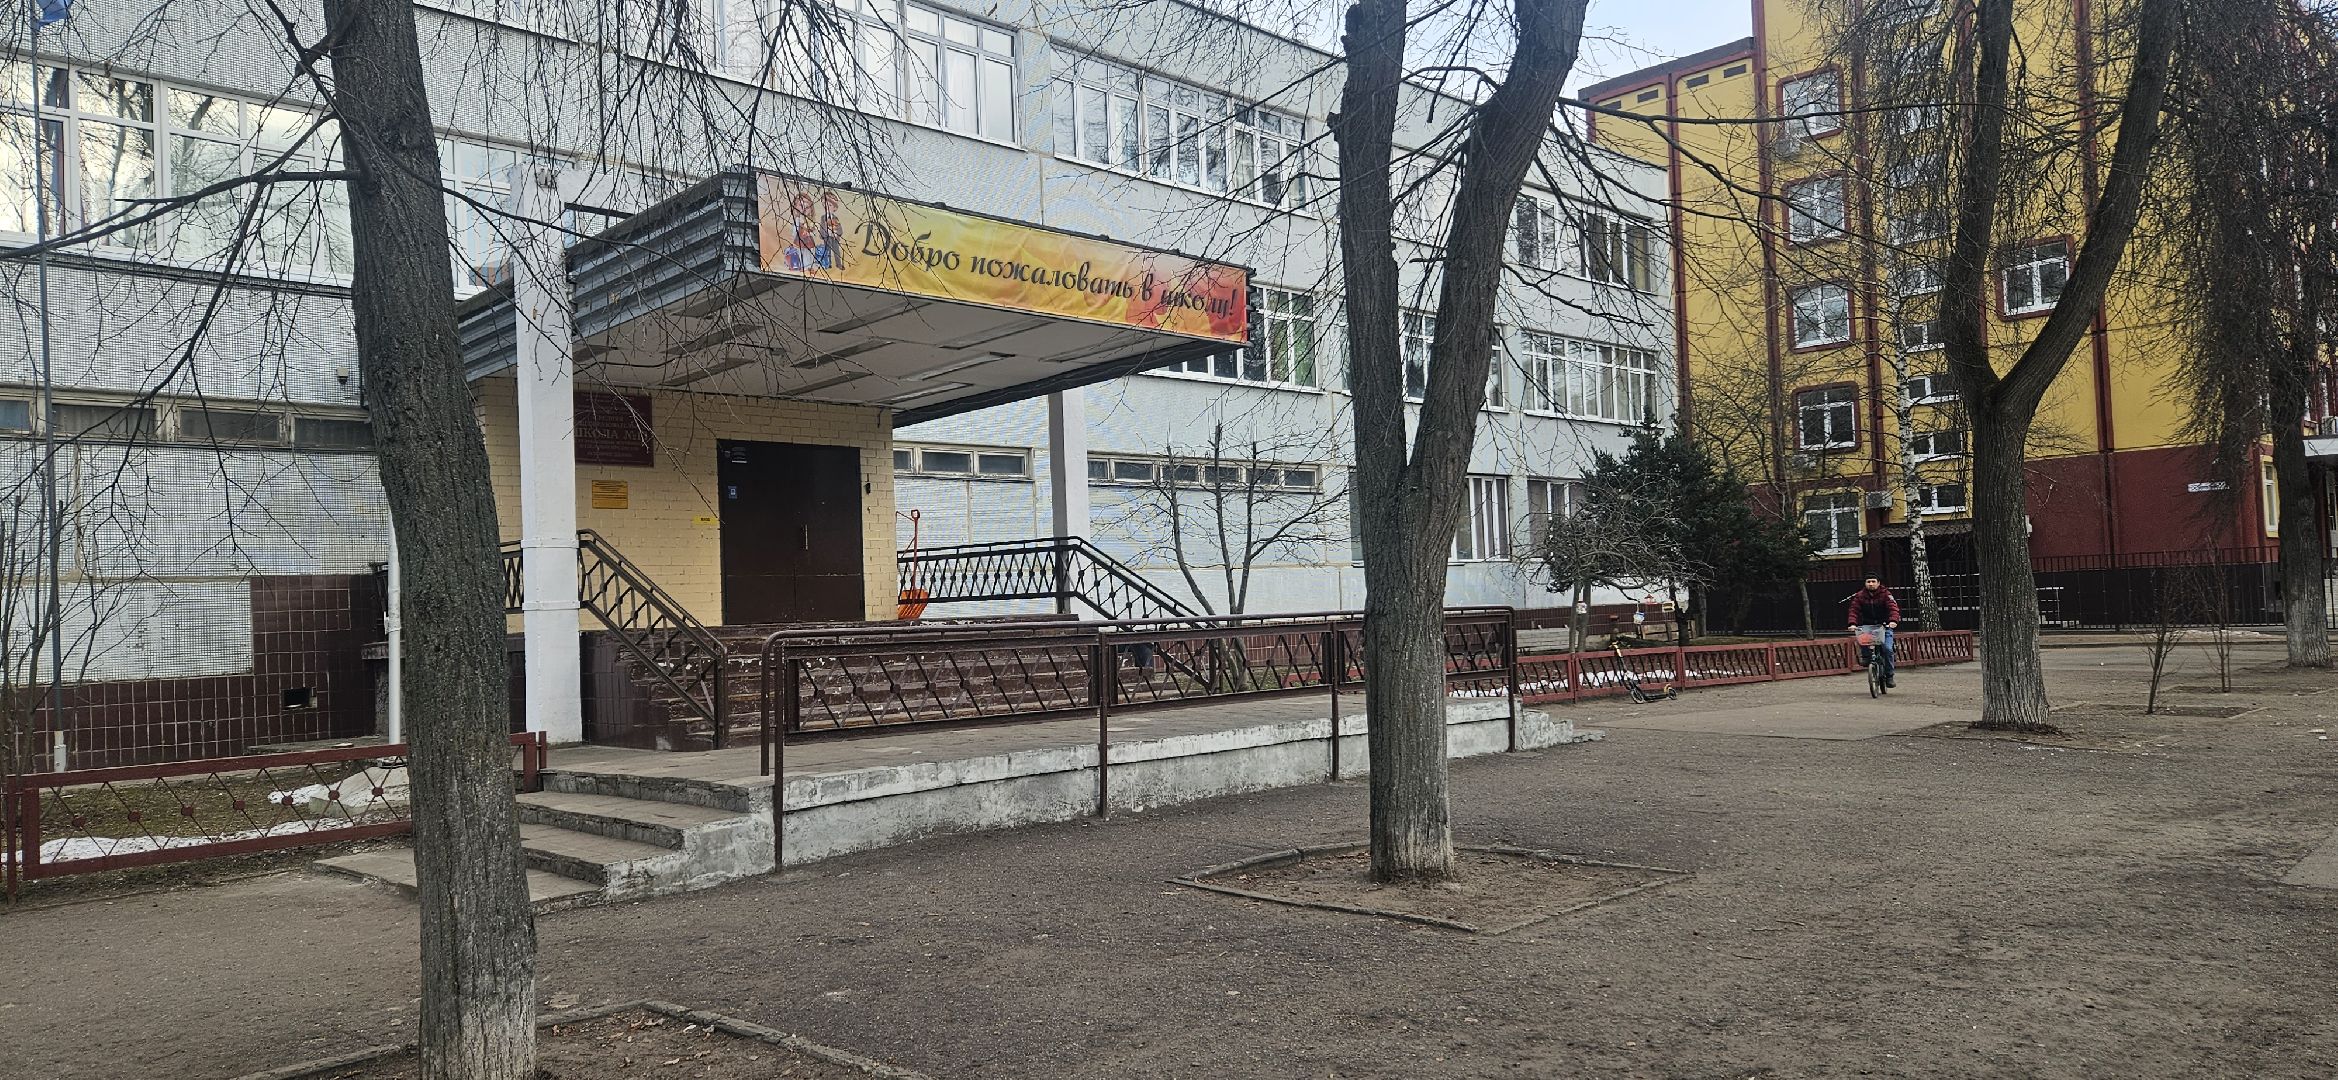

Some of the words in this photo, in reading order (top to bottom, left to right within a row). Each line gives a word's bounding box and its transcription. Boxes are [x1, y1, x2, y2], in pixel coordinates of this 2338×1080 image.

[855, 220, 960, 272] Добро
[970, 255, 1133, 299] пожаловать
[1141, 273, 1154, 302] в
[1160, 288, 1237, 320] школу!
